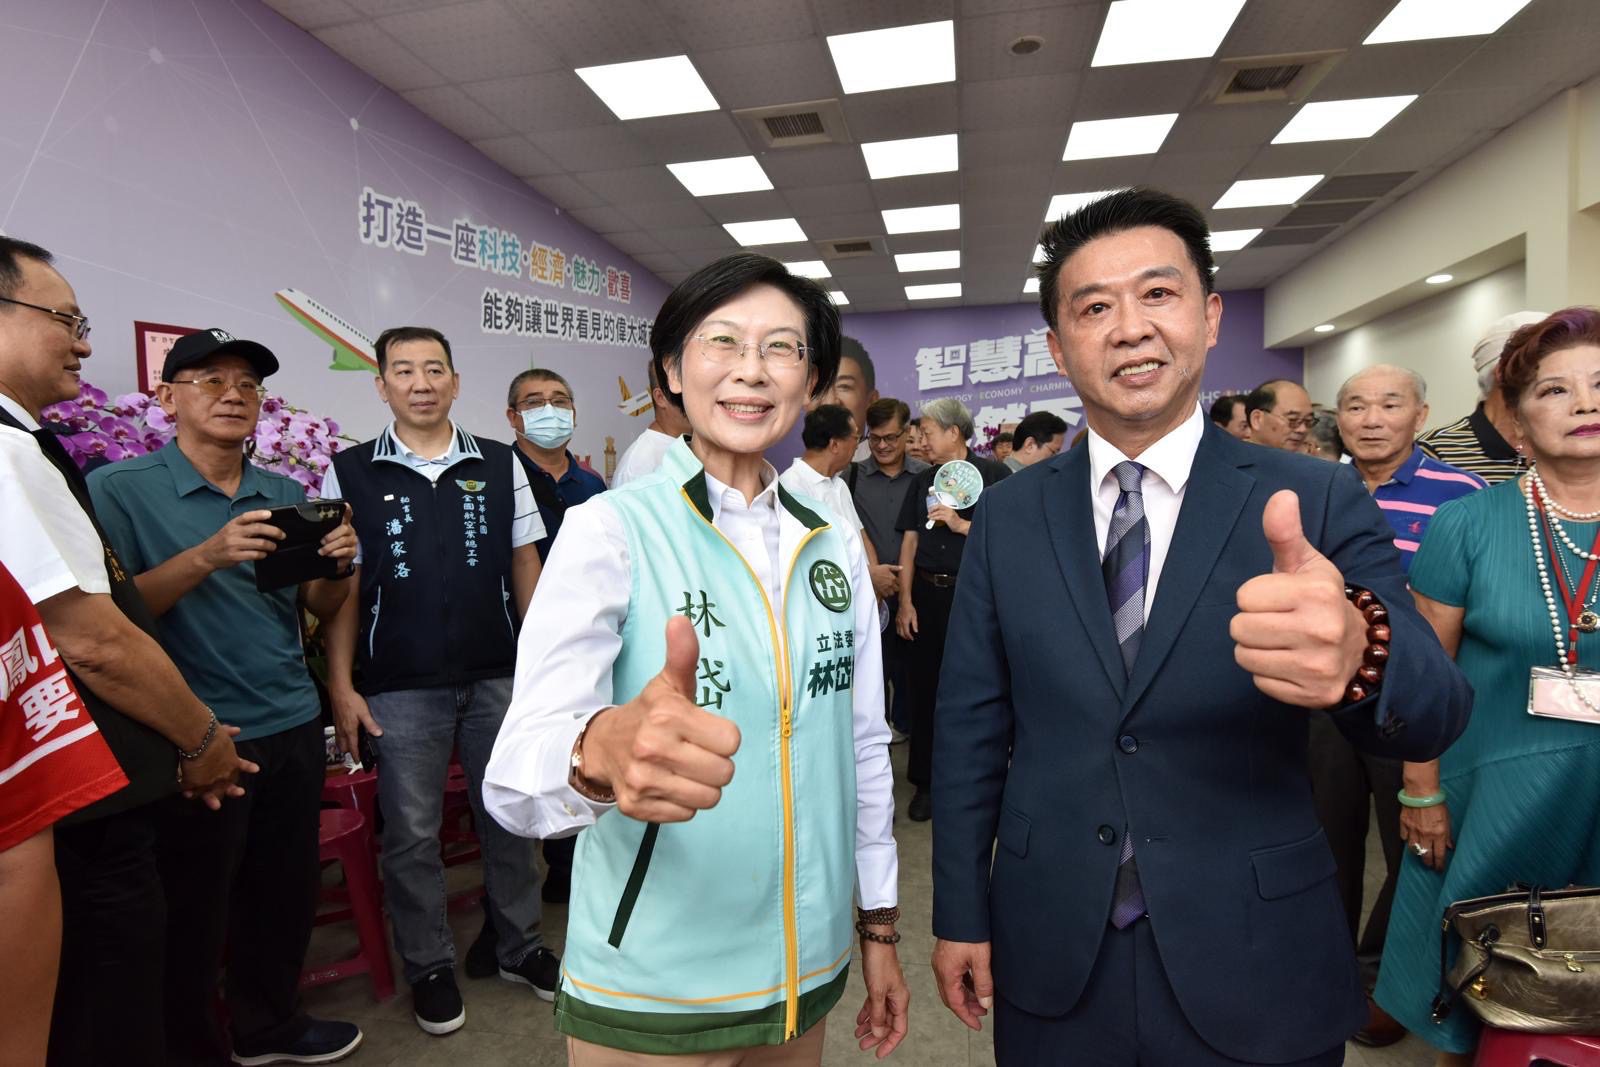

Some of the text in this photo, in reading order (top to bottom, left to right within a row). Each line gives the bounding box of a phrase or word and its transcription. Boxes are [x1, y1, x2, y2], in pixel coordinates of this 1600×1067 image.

[979, 387, 1023, 400] ECONOMY
[476, 494, 488, 535] 中華民國
[17, 668, 80, 742] 要
